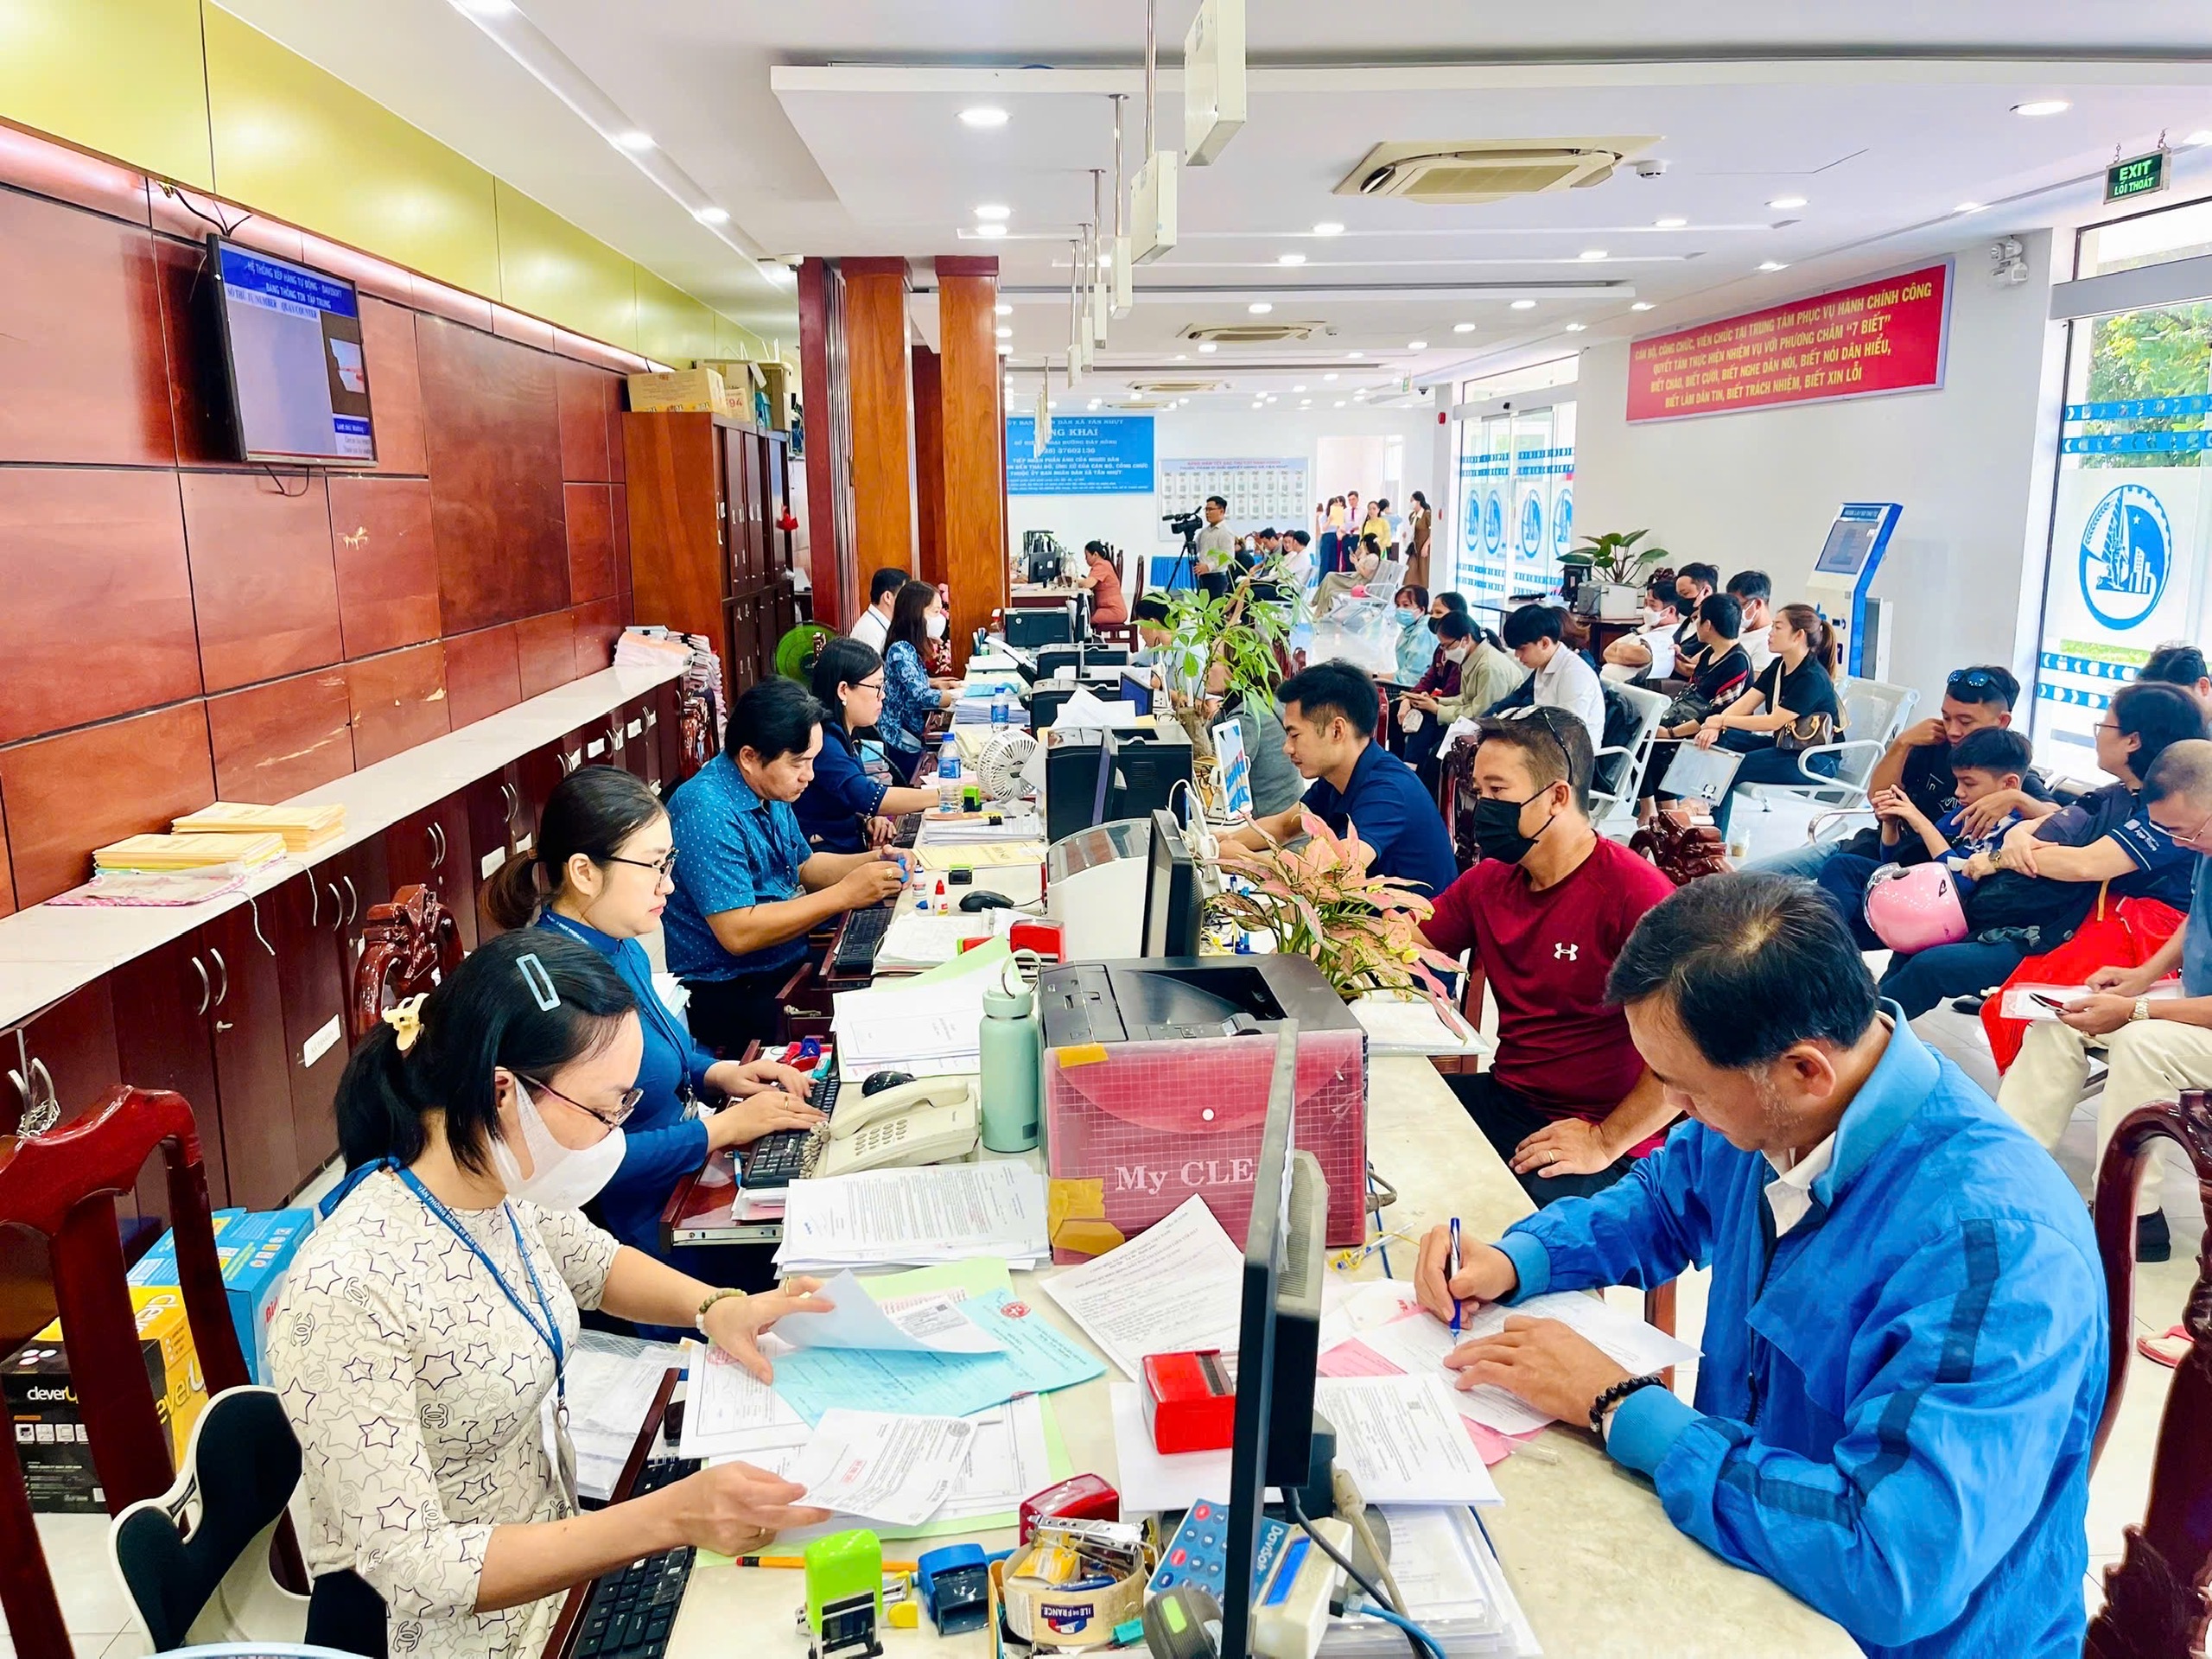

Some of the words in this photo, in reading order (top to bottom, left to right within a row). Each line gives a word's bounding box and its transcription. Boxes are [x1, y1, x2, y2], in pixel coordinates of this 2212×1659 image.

[2114, 180, 2127, 195] LỐI
[2129, 175, 2154, 192] THOÁT
[2120, 159, 2152, 181] EXIT
[1749, 319, 1774, 337] TRUNG
[1777, 311, 1794, 330] TÂM
[1797, 308, 1820, 325] PHỤC
[1823, 303, 1835, 320] VỤ
[1838, 297, 1864, 315] HÀNH
[1867, 289, 1899, 309] CHÍNH
[1902, 282, 1932, 302] CÔNG
[1722, 363, 1738, 381] BIẾT
[1740, 362, 1761, 377] NGHE
[1763, 357, 1779, 374] DÂN
[1800, 347, 1821, 367] BIẾT
[1823, 346, 1839, 363] NÓI
[1842, 342, 1862, 361] DÂN
[1864, 333, 1891, 356] HIỂU,
[1726, 344, 1750, 362] NHIỆM
[1752, 342, 1762, 357] VỤ
[1780, 332, 1814, 350] PHƯƠNG
[1817, 323, 1843, 342] CHÂM
[1726, 381, 1743, 400] BIẾT
[1746, 379, 1770, 397] TRÁCH
[1773, 374, 1802, 394] NHIỆM,
[1805, 368, 1825, 388] BIẾT
[1827, 369, 1843, 385] XIN
[1846, 361, 1862, 382] LỖI
[1115, 1164, 1168, 1195] My
[1181, 1158, 1258, 1186] CLE
[1044, 1607, 1072, 1617] FRANCE
[1080, 1607, 1091, 1616] ILE
